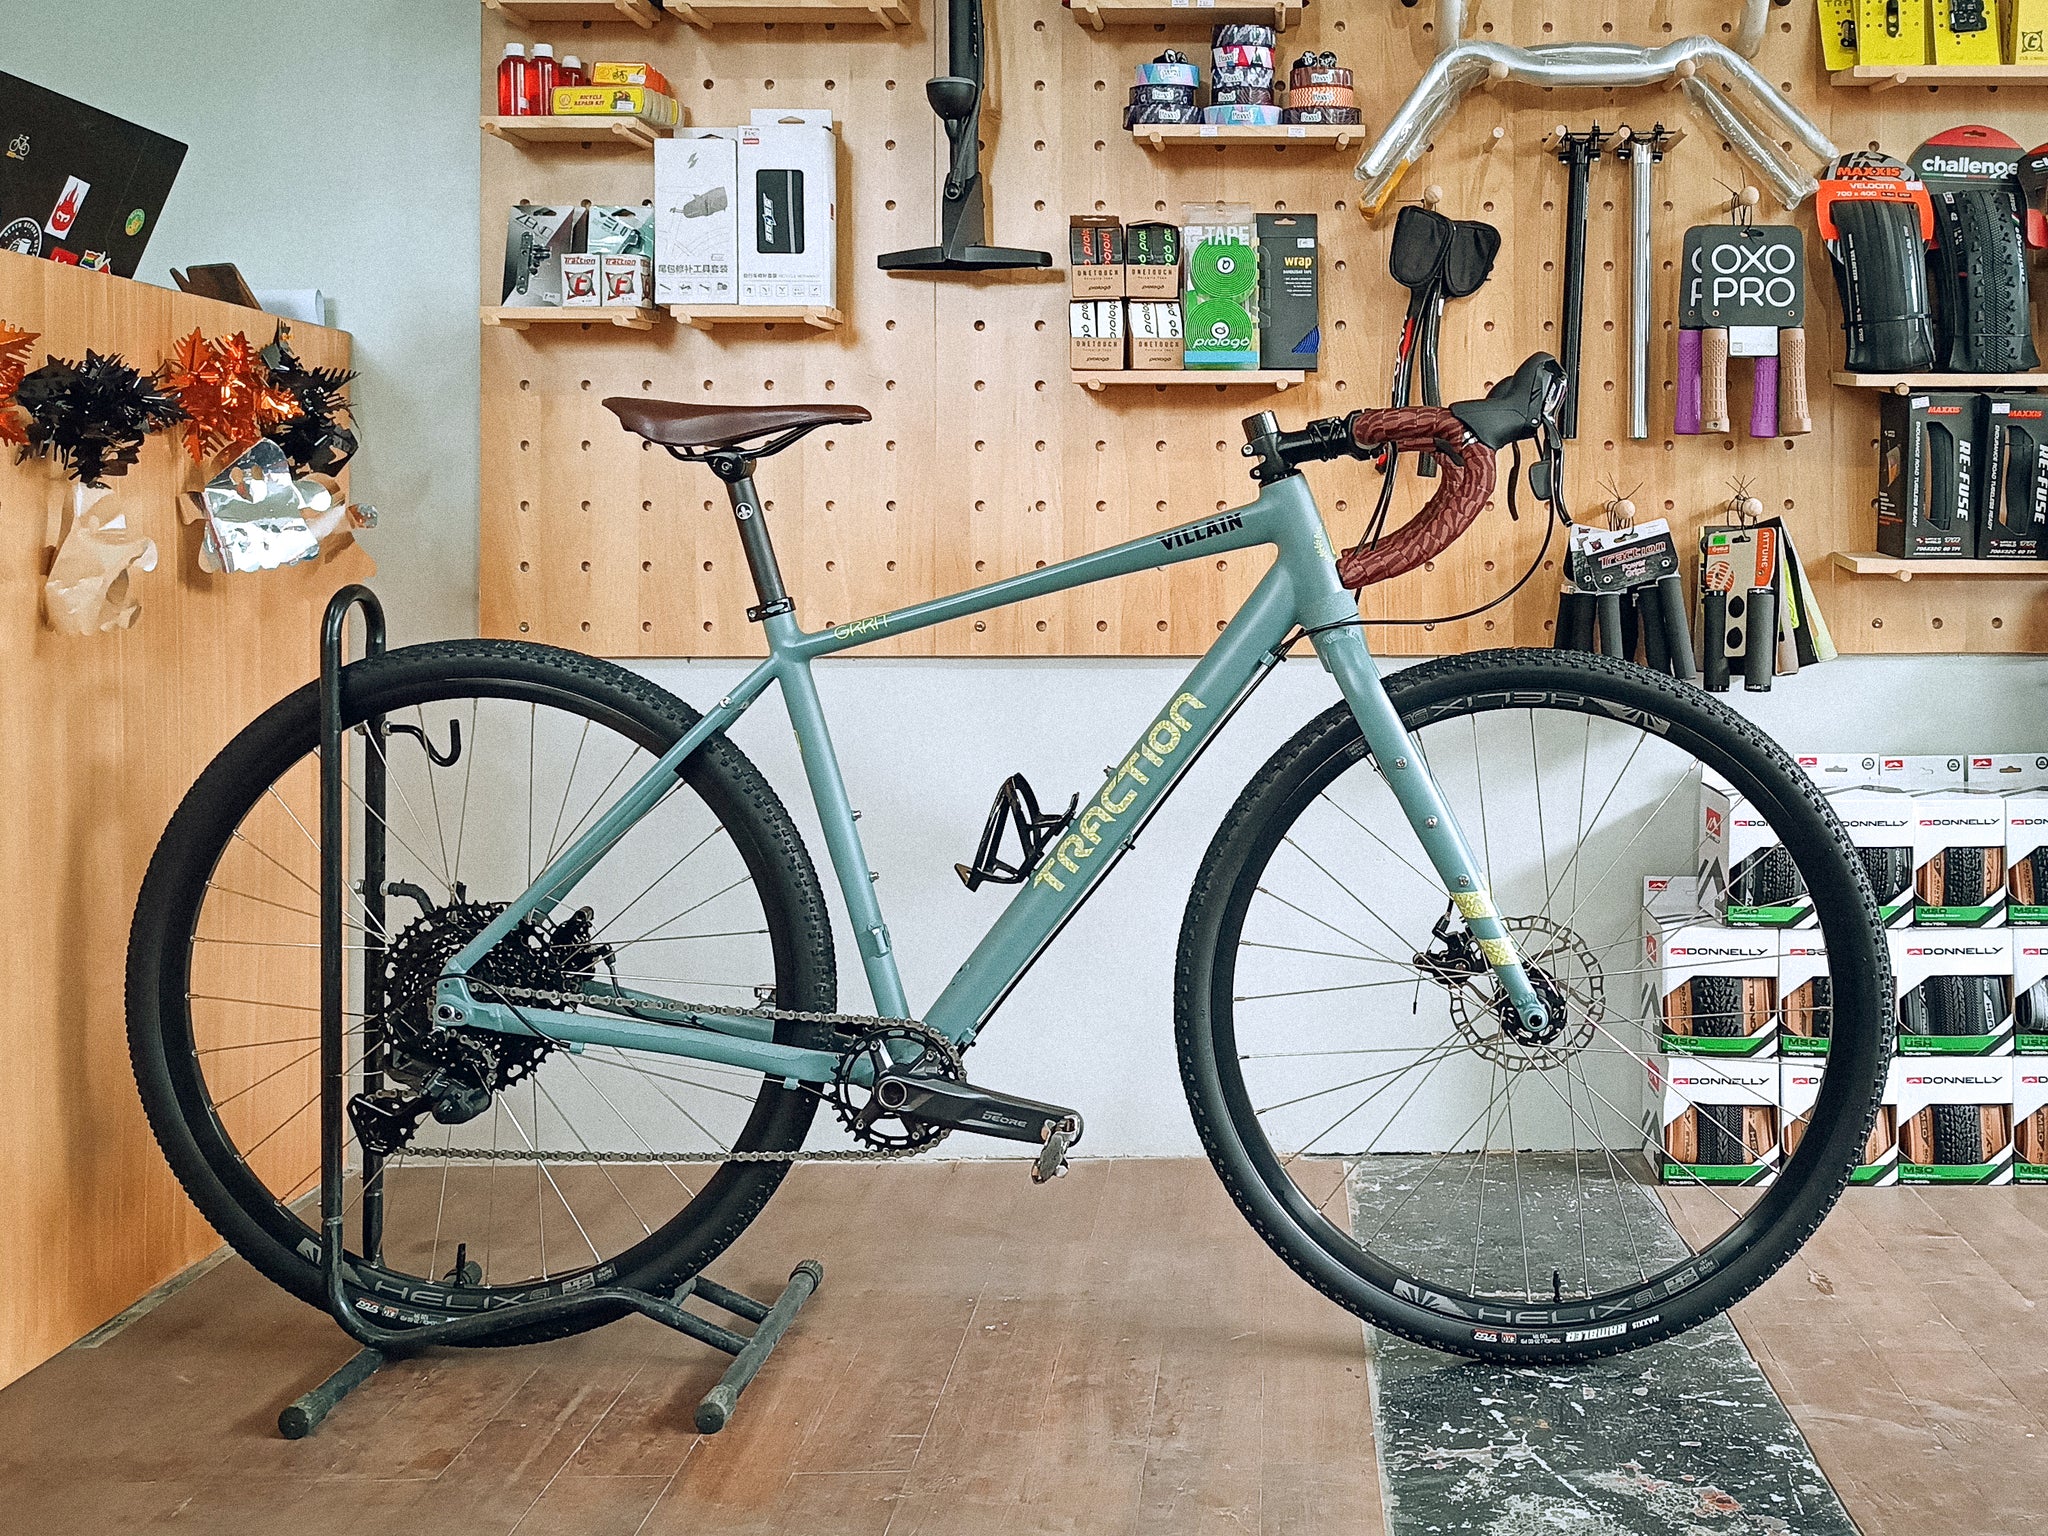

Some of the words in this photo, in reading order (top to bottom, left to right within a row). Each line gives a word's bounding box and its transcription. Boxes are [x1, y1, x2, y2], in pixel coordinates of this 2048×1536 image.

[1837, 167, 1901, 176] MAXXIS
[1921, 156, 2018, 179] challenge
[564, 256, 596, 265] Traction
[605, 257, 636, 266] Traction
[1284, 256, 1313, 269] wrap
[1711, 244, 1796, 274] OXO
[1713, 276, 1796, 307] PRO
[1193, 337, 1251, 349] prologo
[1927, 406, 1963, 414] MAXXIS
[2008, 410, 2043, 418] MAXXIS
[1956, 440, 1971, 522] RE-FUSE
[2034, 444, 2048, 525] RE-FUSE
[1157, 512, 1244, 551] VILLAIN
[1598, 540, 1667, 569] Traction
[1760, 531, 1770, 568] ATTUNE
[1621, 559, 1647, 572] Power
[1033, 692, 1206, 892] TRACTION
[1932, 818, 2000, 826] DONNELLY
[2013, 906, 2041, 914] MSO
[1686, 948, 1769, 956] DONNELLY
[1923, 947, 2004, 955] DONNELLY
[1669, 1037, 1699, 1045] MSO
[1788, 1038, 1820, 1046] MSO
[1689, 1077, 1770, 1086] DONNELLY
[1922, 1076, 2003, 1084] DONNELLY
[982, 1112, 1028, 1128] DEORE
[1903, 1166, 1935, 1174] MSO
[375, 1280, 525, 1310] HELIX
[1478, 1299, 1633, 1325] HELIX
[1631, 1314, 1660, 1329] MAXXIS
[1565, 1322, 1627, 1343] RAMBLER
